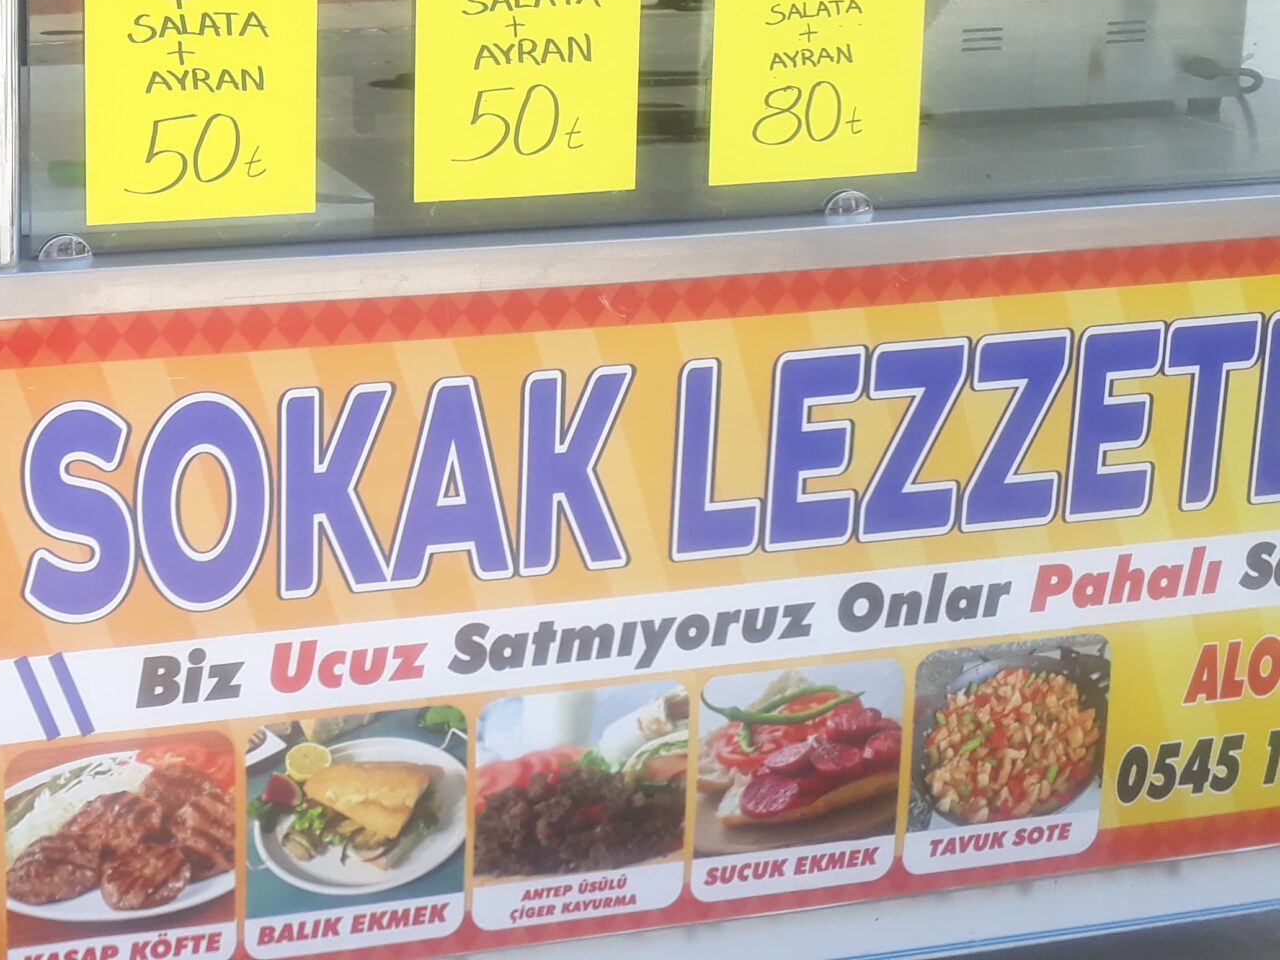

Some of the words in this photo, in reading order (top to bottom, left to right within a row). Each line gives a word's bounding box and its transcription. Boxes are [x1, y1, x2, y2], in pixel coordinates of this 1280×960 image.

[127, 11, 270, 44] SALATA
[505, 16, 526, 38] +
[799, 23, 819, 43] +
[167, 41, 196, 66] +
[473, 33, 593, 70] AYRAN
[769, 44, 854, 72] AYRAN
[145, 66, 266, 95] AYRAN
[21, 363, 634, 625] SOKAK
[135, 647, 246, 709] Biz
[270, 640, 430, 694] Ucuz
[447, 600, 817, 676] Satmıyoruz
[836, 572, 1013, 633] Onlar
[1030, 546, 1223, 615] Pahalı
[1238, 541, 1280, 590] S
[1181, 635, 1280, 706] ALO
[1116, 733, 1246, 806] 0545
[928, 830, 1008, 859] TAVUK
[1012, 820, 1074, 849] SOTE
[703, 857, 787, 887] SUCUK
[793, 846, 881, 876] EKMEK
[520, 884, 573, 902] ANTEP
[561, 894, 638, 914] KAVURMA
[257, 918, 346, 946] BALIK
[349, 902, 451, 935] EKMEK
[129, 932, 223, 960] KÖFTE
